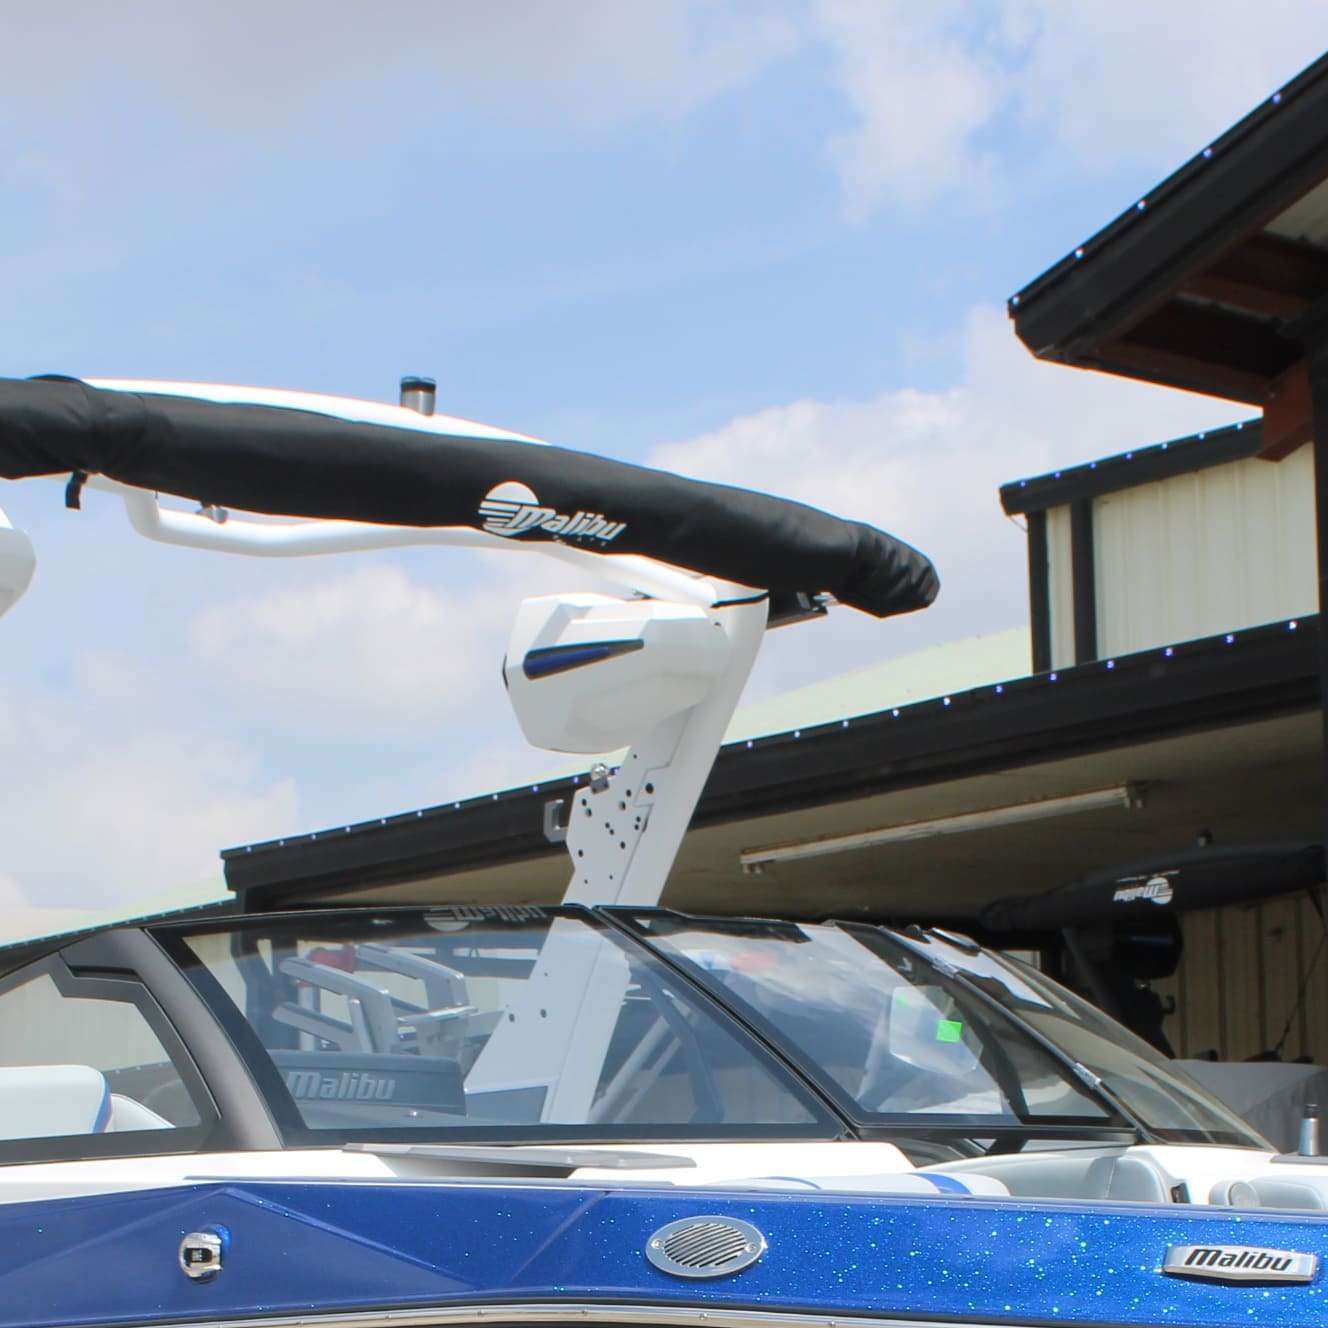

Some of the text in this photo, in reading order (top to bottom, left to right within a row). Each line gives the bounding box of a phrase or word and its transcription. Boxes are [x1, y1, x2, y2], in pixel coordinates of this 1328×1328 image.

[504, 503, 628, 541] Malibu
[287, 1071, 397, 1099] Malibu
[1184, 1248, 1293, 1272] Malibu
